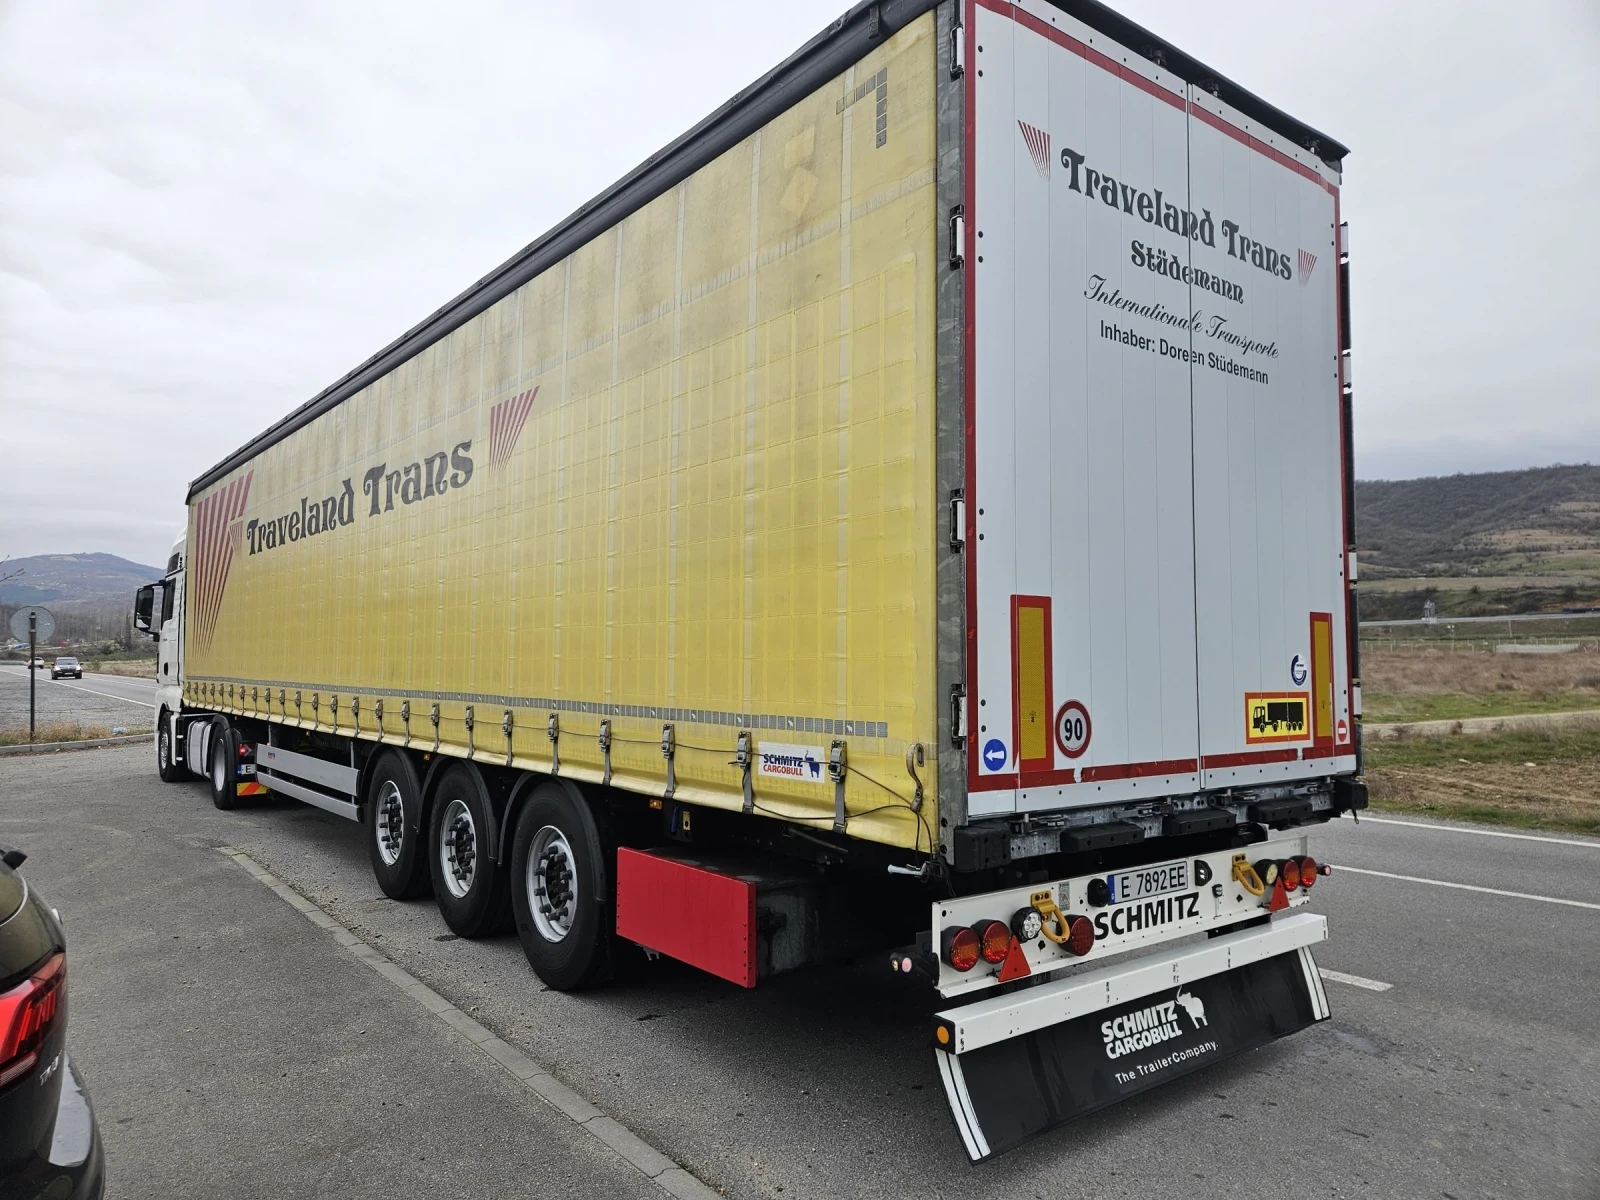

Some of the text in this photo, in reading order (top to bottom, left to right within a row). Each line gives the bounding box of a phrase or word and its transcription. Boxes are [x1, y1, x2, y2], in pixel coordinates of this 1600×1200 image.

[1060, 147, 1292, 281] Traveland Trans
[1131, 239, 1244, 304] Stüdemann
[1083, 274, 1279, 359] Internationale Transporte
[1100, 319, 1269, 385] Inhaber: Doreen Stüdemann
[246, 439, 475, 557] Traveland Trans
[1064, 717, 1083, 741] 90
[763, 753, 804, 768] SCHMITZ
[763, 764, 804, 777] CARGOBULL
[1094, 891, 1200, 941] SCHMITZ
[1101, 1000, 1178, 1043] SCHMITZ
[1106, 1021, 1183, 1060] CARGOBULL
[1115, 1071, 1136, 1085] The
